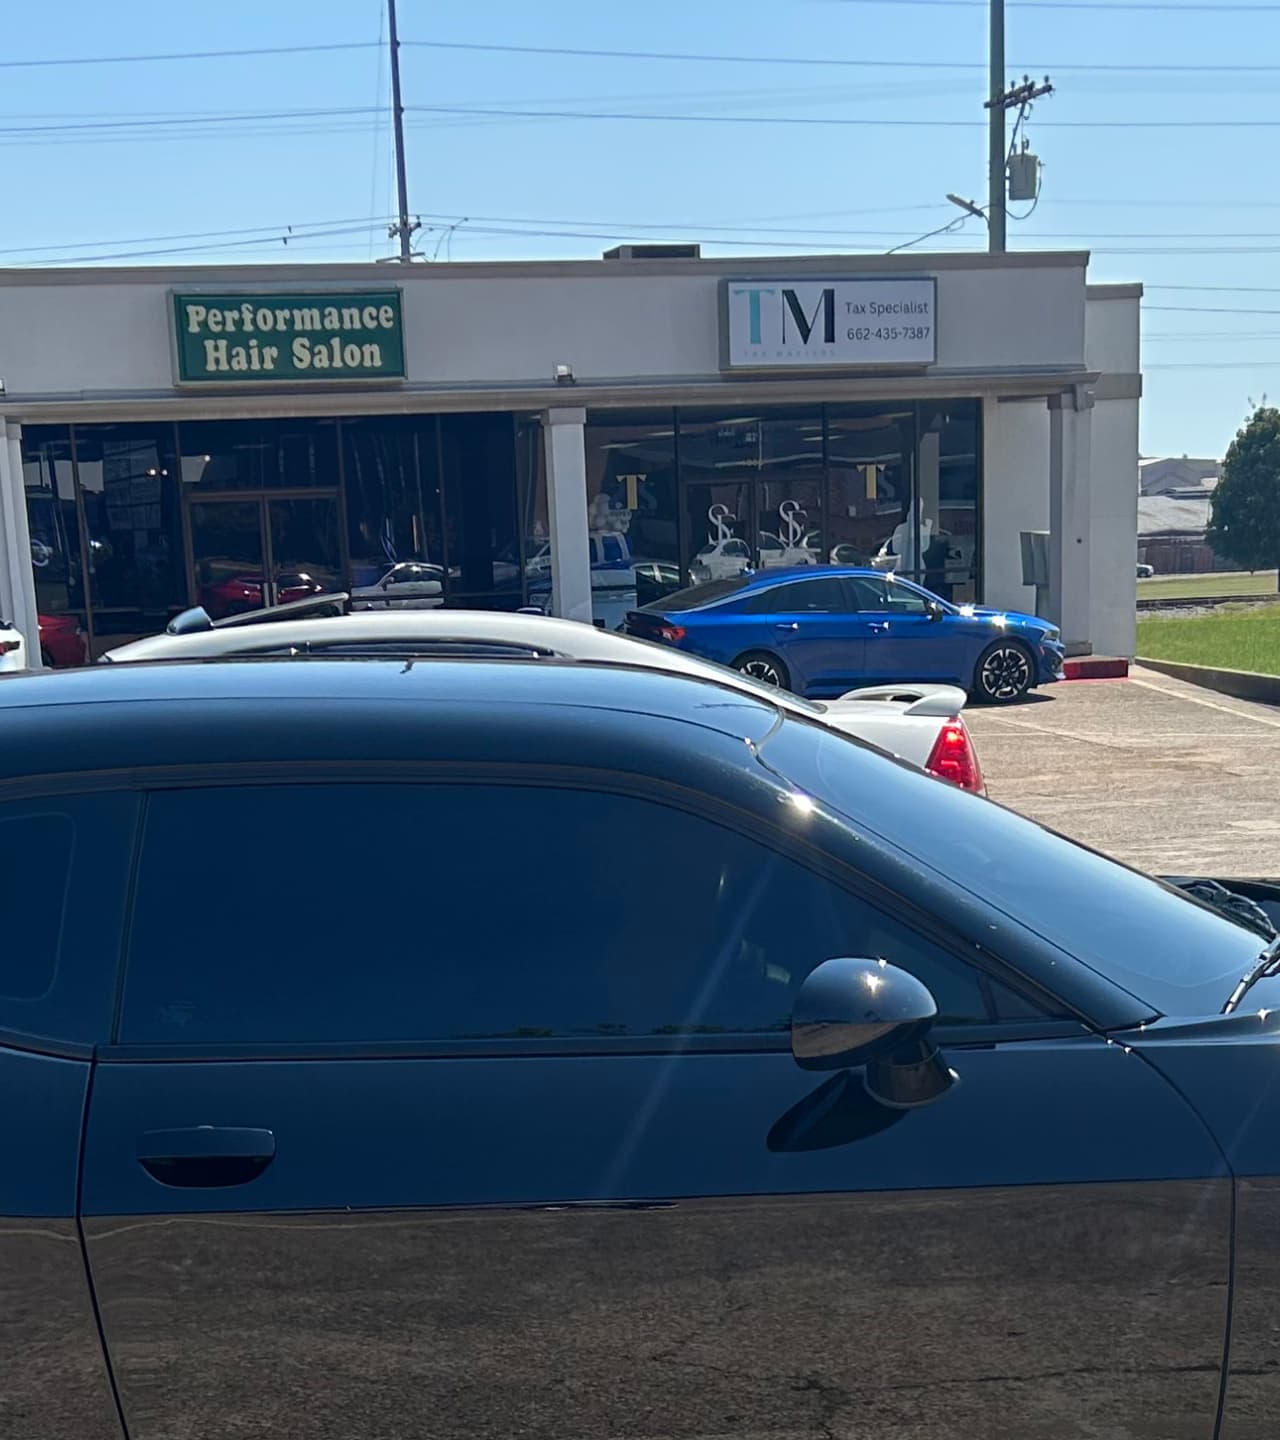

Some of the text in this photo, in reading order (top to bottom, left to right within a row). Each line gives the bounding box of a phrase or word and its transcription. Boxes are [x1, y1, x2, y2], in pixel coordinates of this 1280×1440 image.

[186, 303, 394, 333] Performance
[734, 288, 835, 345] TM
[845, 301, 929, 317] Tax Specialist
[847, 327, 930, 340] 662-435-7387
[203, 337, 382, 371] Hair Salon
